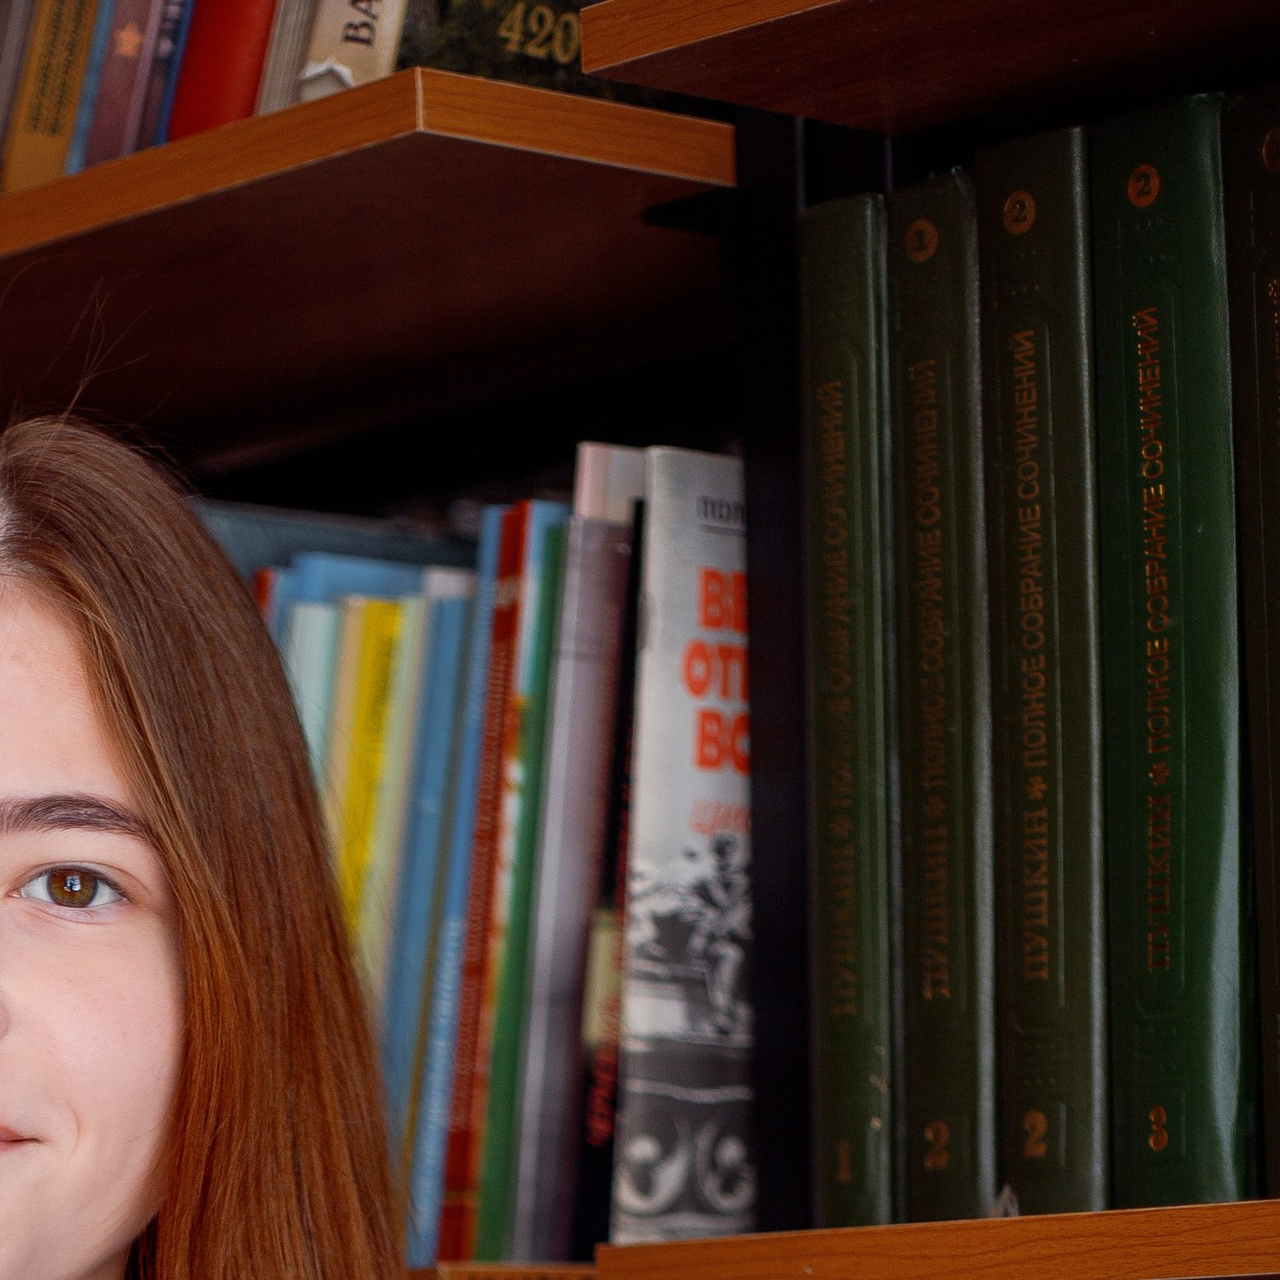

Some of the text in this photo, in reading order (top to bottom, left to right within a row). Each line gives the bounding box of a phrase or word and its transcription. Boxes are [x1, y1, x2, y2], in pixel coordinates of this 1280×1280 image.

[498, 2, 580, 64] 420
[908, 359, 950, 1001] ПУШКИН ПОЛНОЕ СОБРАНИЕ СОЧИНЕНИЙ
[1013, 329, 1050, 982] ПУШКИН ПОЛНОЕ СОБРАНИЕ СОЧИНЕНИЙ
[1132, 305, 1172, 973] ПУШКИН ПОЛНОЕ СОБРАНИЕ СОЧИНЕНИЙ
[1023, 1108, 1050, 1160] 2
